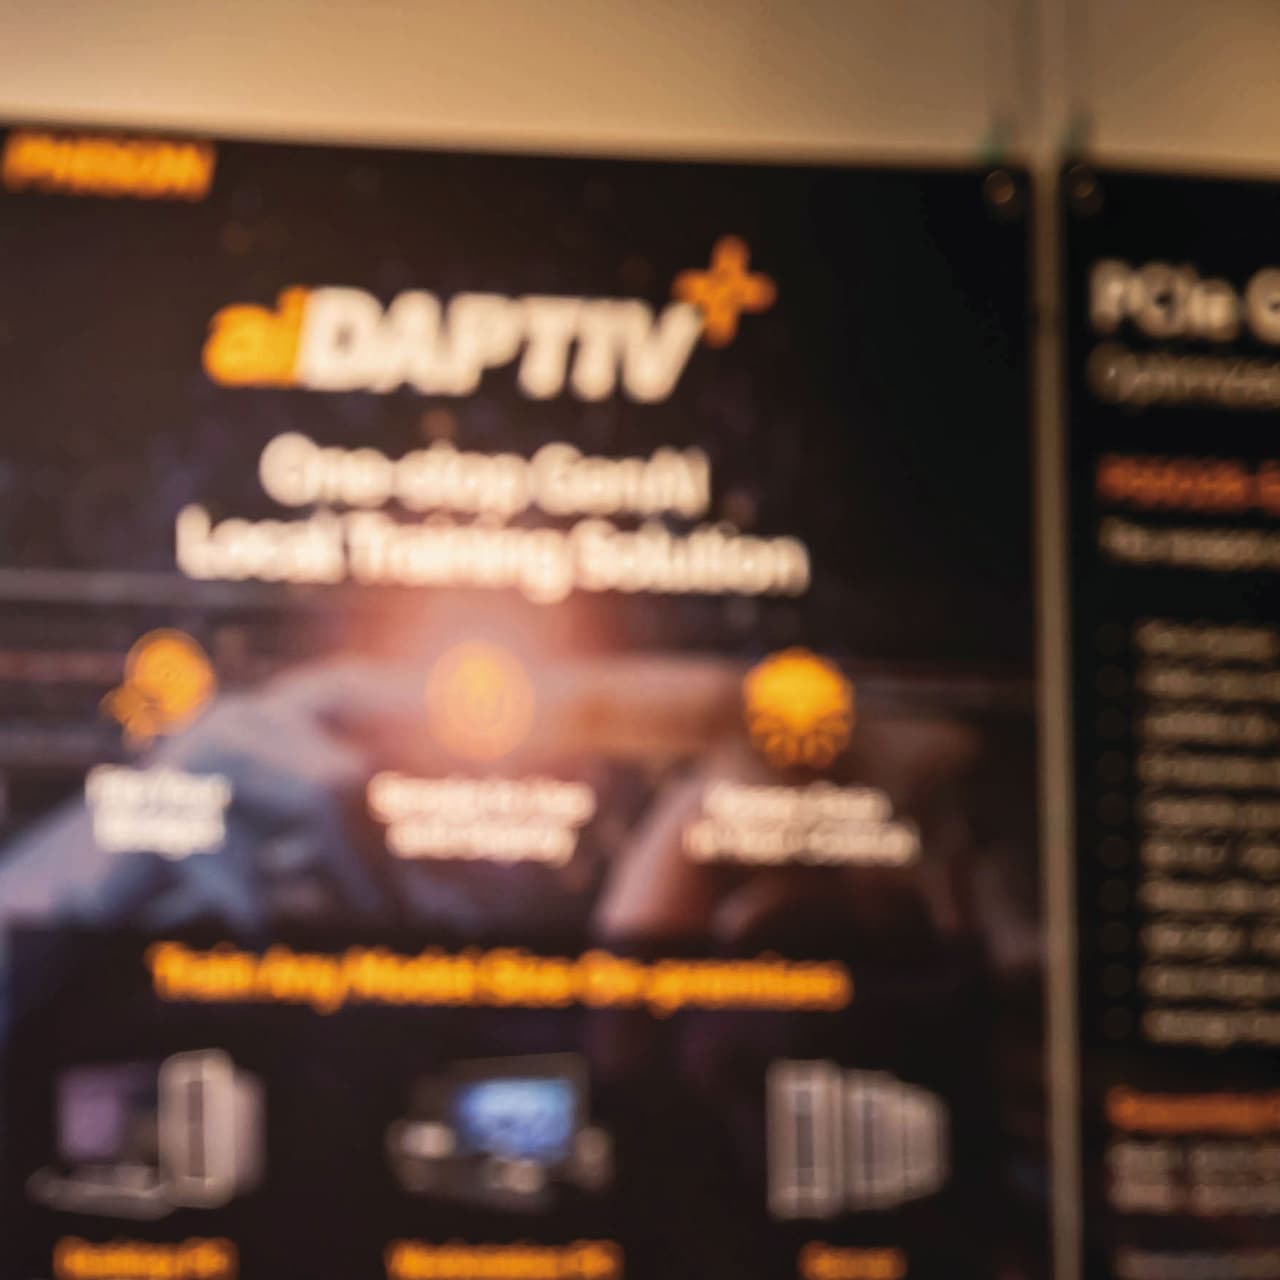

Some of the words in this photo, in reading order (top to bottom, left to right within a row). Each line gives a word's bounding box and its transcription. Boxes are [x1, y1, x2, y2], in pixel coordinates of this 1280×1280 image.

[176, 503, 343, 583] Local
[345, 510, 573, 605] Training
[573, 518, 811, 598] Solution
